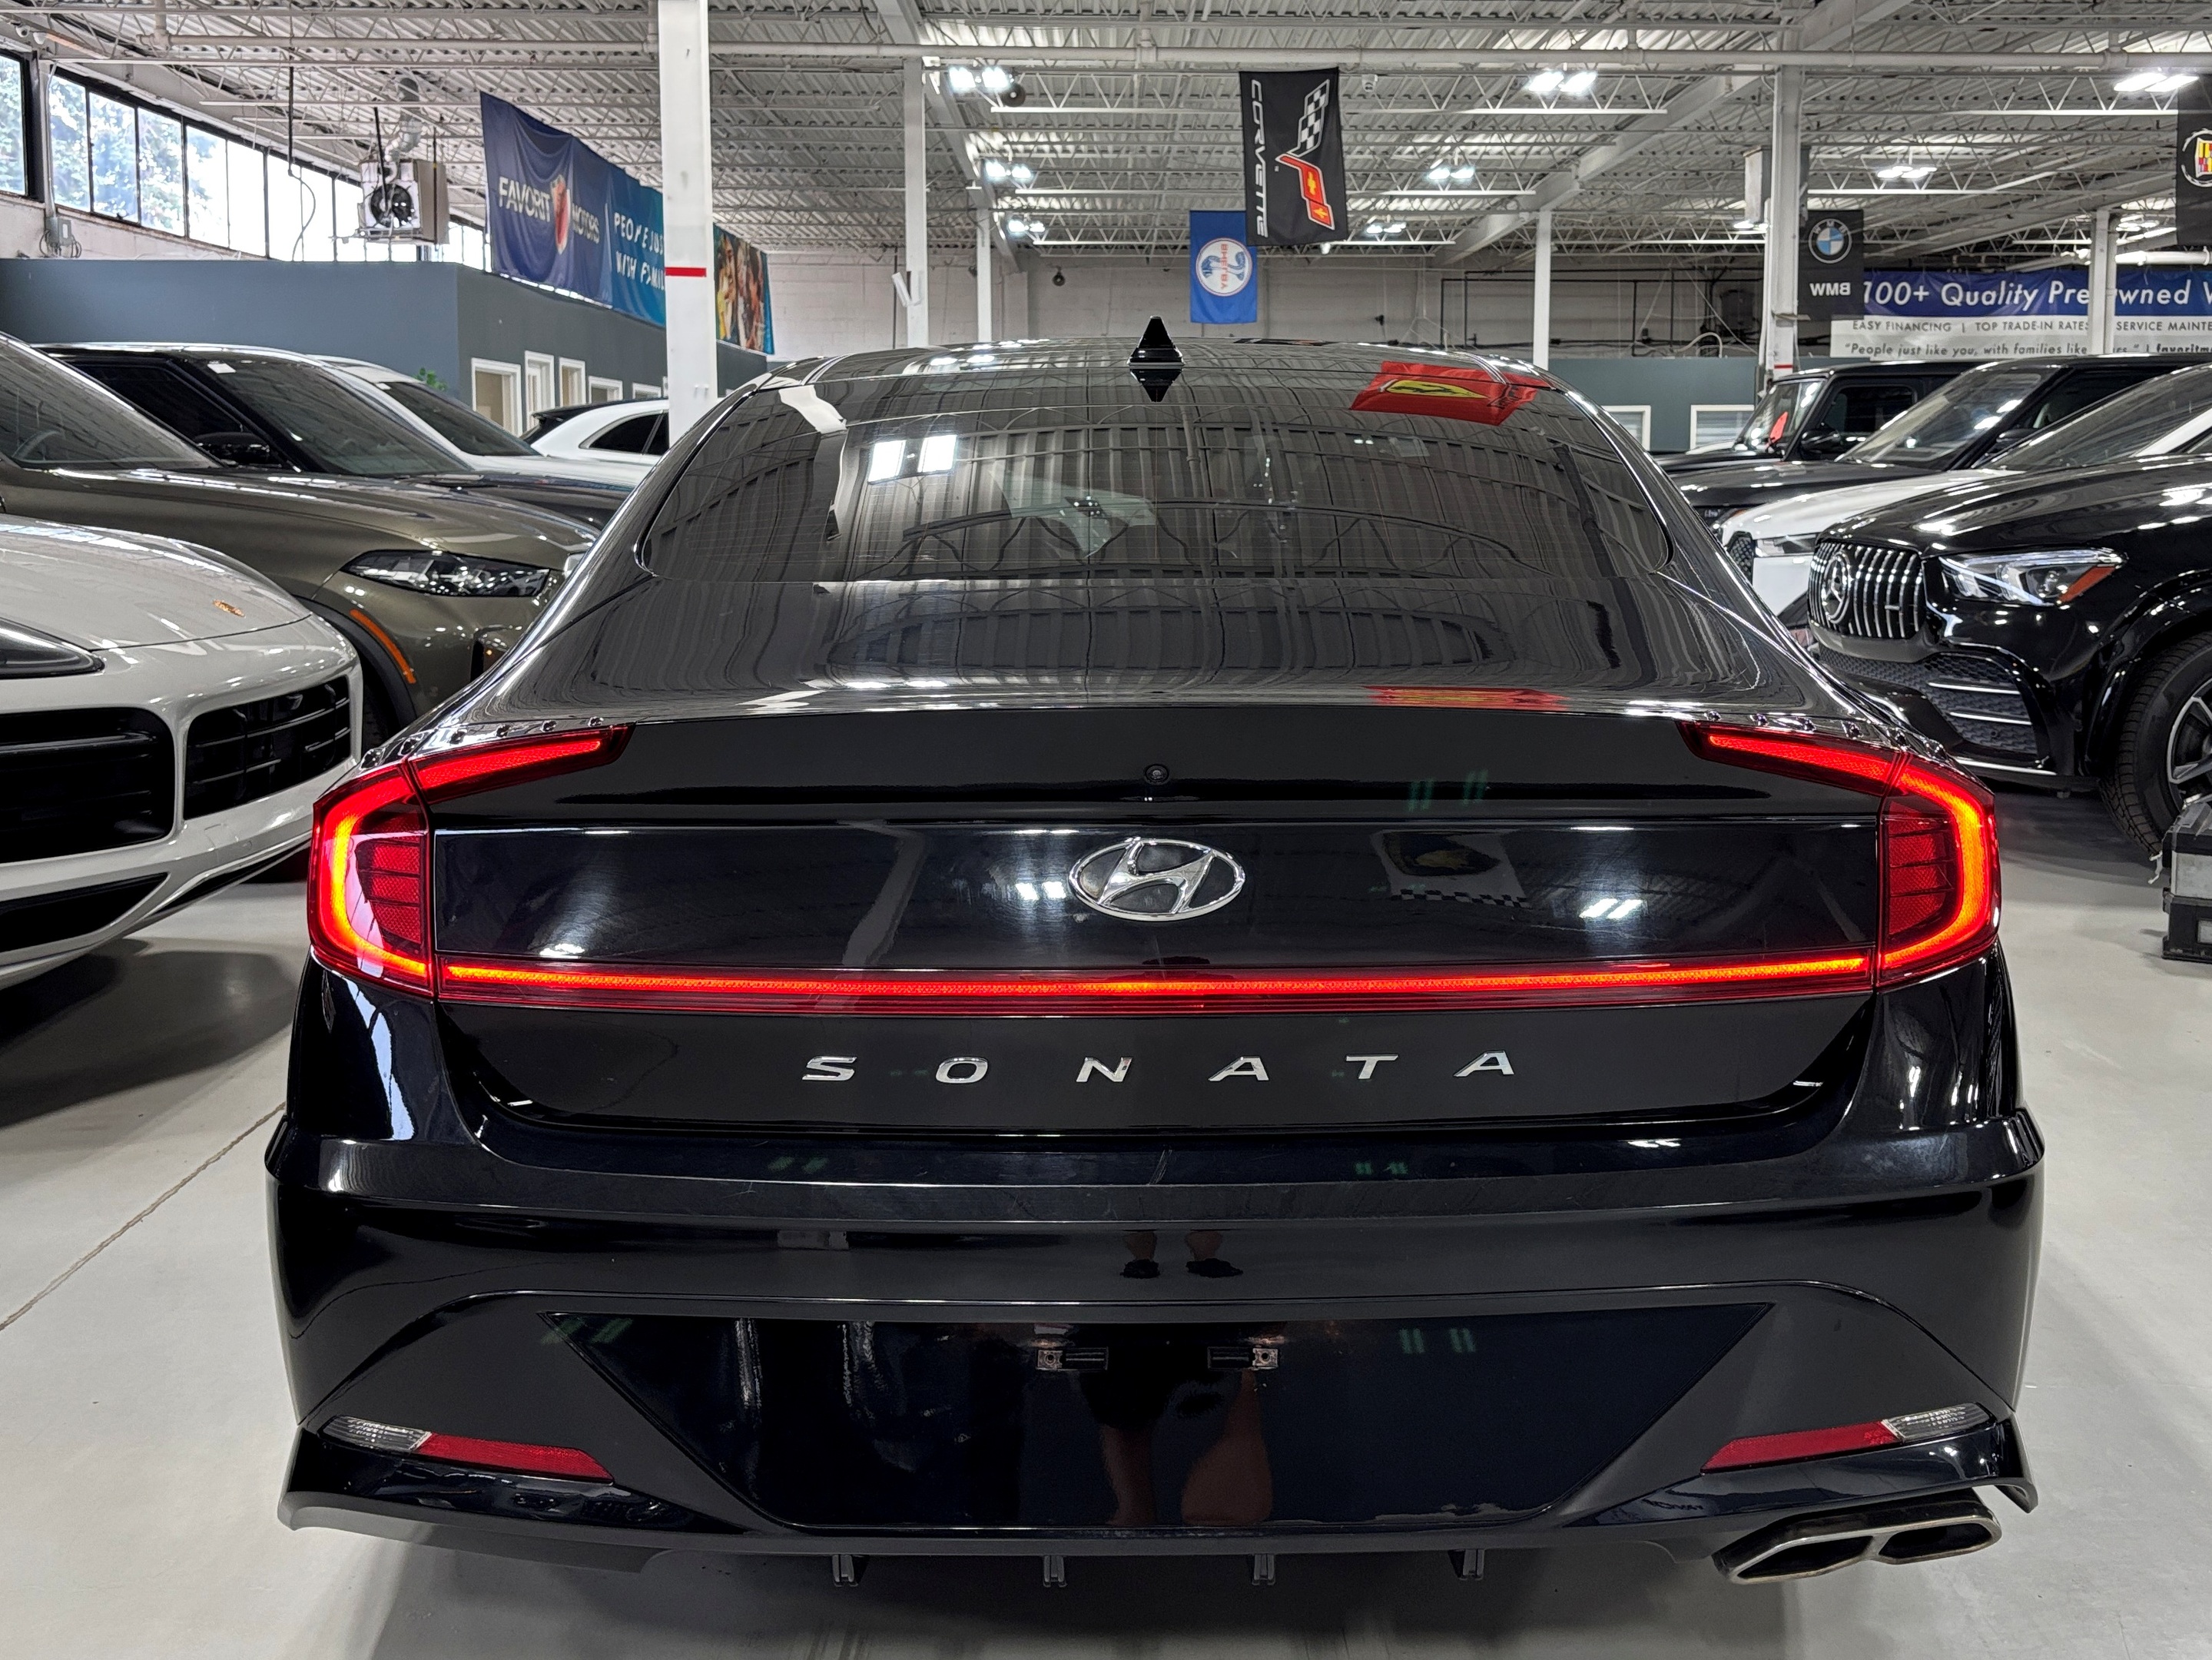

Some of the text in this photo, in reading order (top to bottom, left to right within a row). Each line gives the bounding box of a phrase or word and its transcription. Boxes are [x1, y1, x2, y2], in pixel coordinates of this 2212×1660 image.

[1252, 79, 1268, 237] CORVETTE
[499, 176, 551, 223] FAVORIT
[648, 231, 664, 255] JUS
[640, 262, 665, 290] FAMIL
[1863, 281, 1930, 305] 100+
[1941, 280, 2038, 311] Quality
[1852, 320, 1882, 330] EASY
[1885, 321, 1952, 333] FINANCING
[1975, 322, 1998, 332] TOP
[2002, 320, 2053, 331] TRADE-IN
[2116, 321, 2163, 331] SERVICE
[1898, 344, 1922, 357] just
[1925, 344, 1948, 355] like
[1983, 344, 2008, 354] with
[2013, 343, 2062, 354] families
[2066, 343, 2088, 354] like
[802, 1050, 1514, 1083] SONATA
